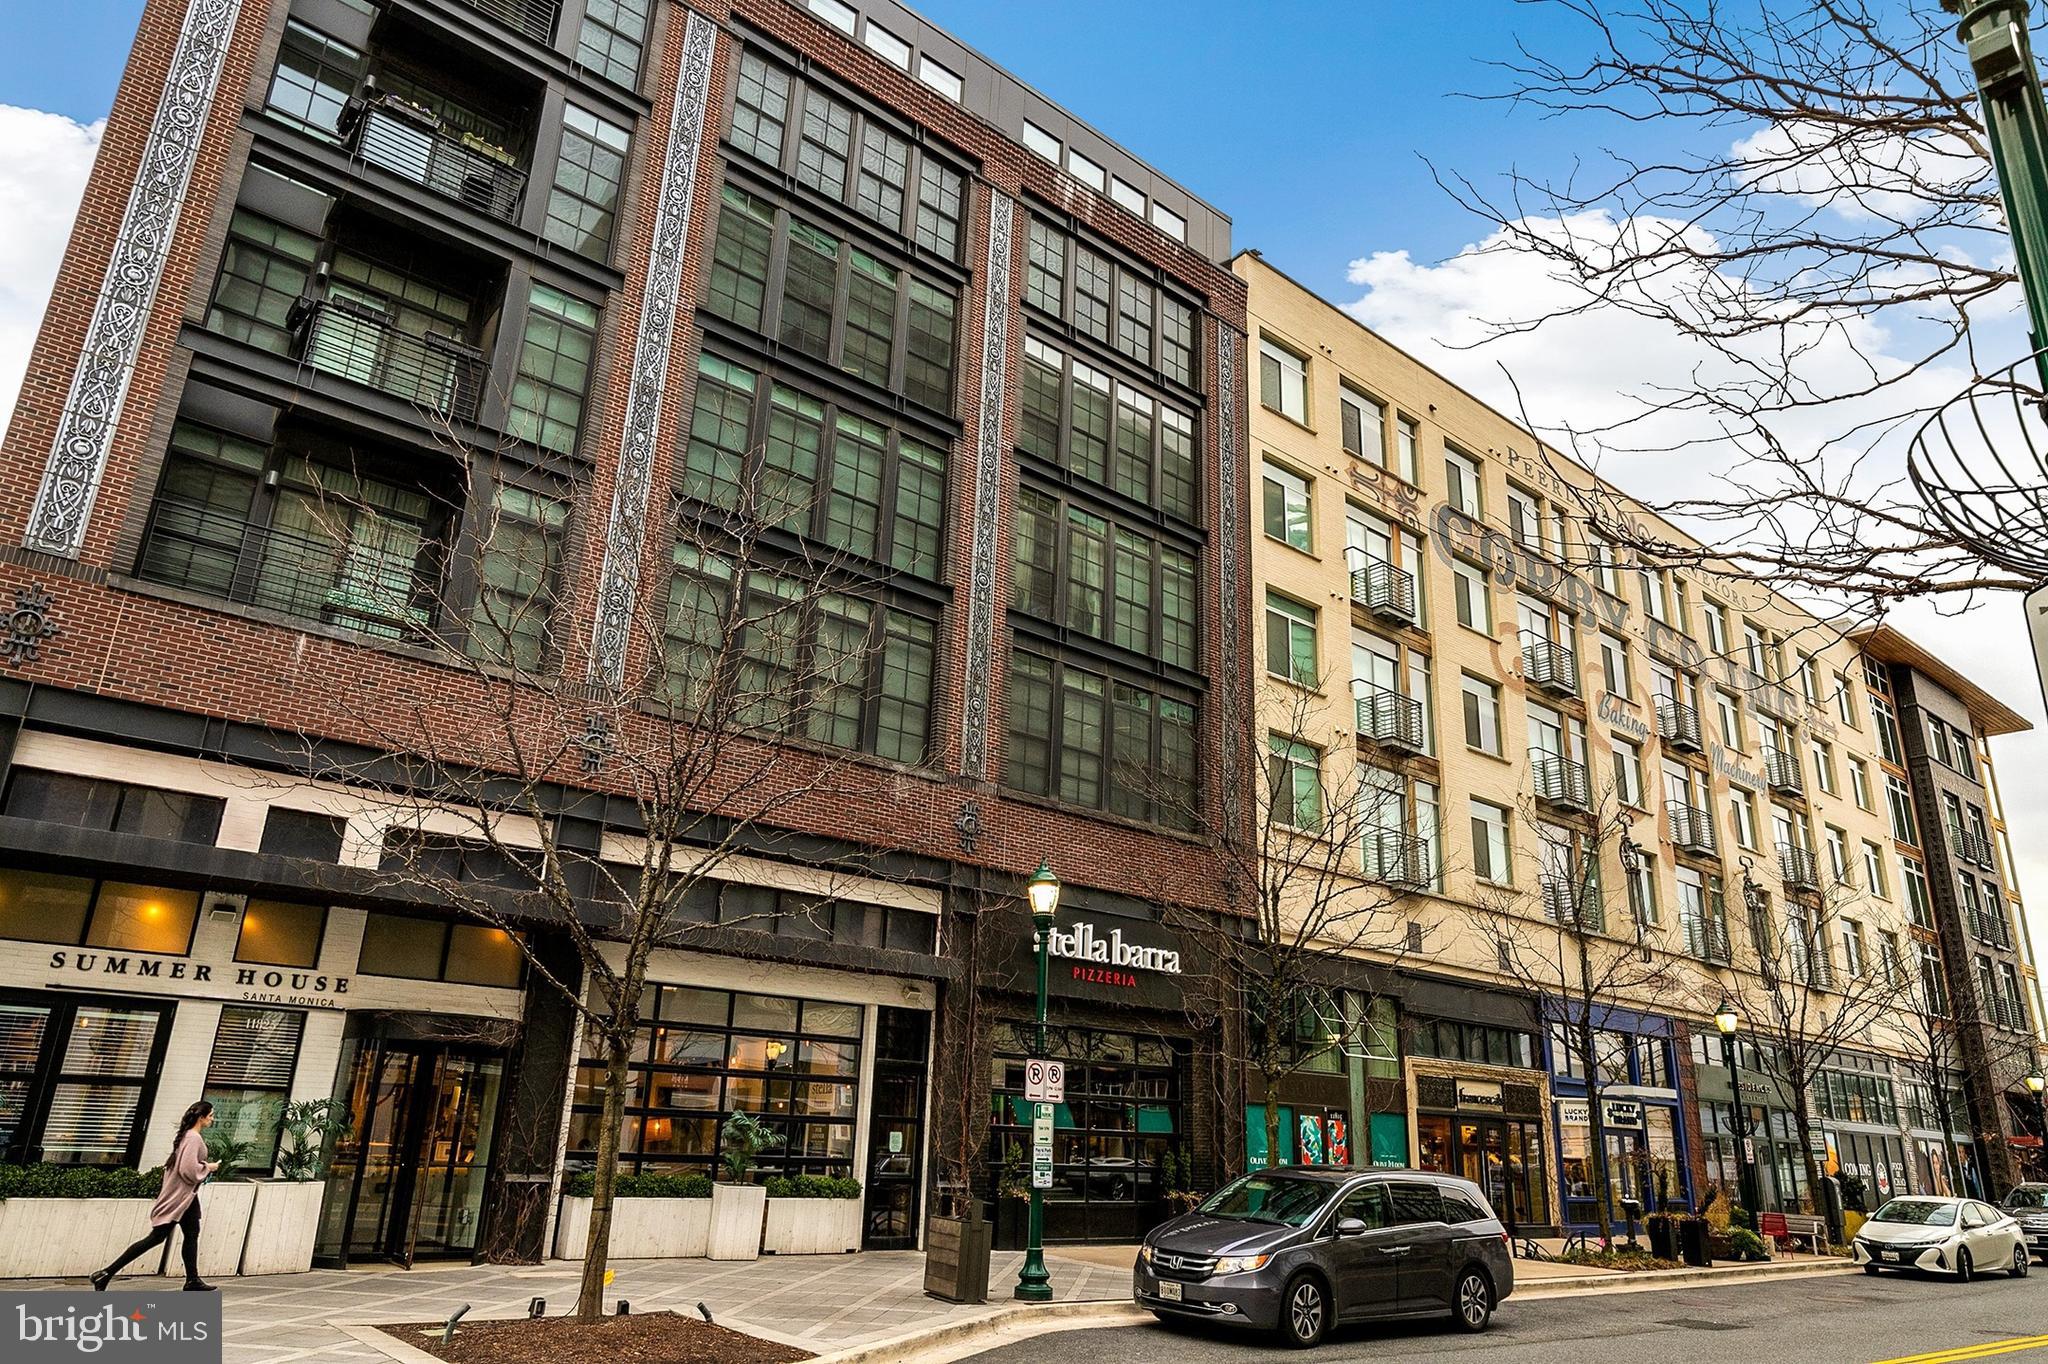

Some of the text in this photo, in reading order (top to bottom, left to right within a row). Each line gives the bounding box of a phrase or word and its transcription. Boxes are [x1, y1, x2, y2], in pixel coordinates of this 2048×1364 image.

[1430, 500, 1632, 636] CORBY
[1598, 693, 1648, 743] Baking
[1711, 740, 1767, 796] Machinery
[1110, 928, 1182, 974] barra
[50, 951, 349, 994] SUMMER HOUSE
[1072, 966, 1137, 988] PIZZERIA
[242, 991, 335, 1007] SANTA MONICA
[245, 1017, 277, 1031] 11825
[1564, 1108, 1589, 1116] LUCKY
[1611, 1102, 1636, 1113] LUCKY
[1564, 1115, 1589, 1123] BRAND
[1250, 1156, 1267, 1165] OLIVE
[1844, 1162, 1872, 1177] COMING
